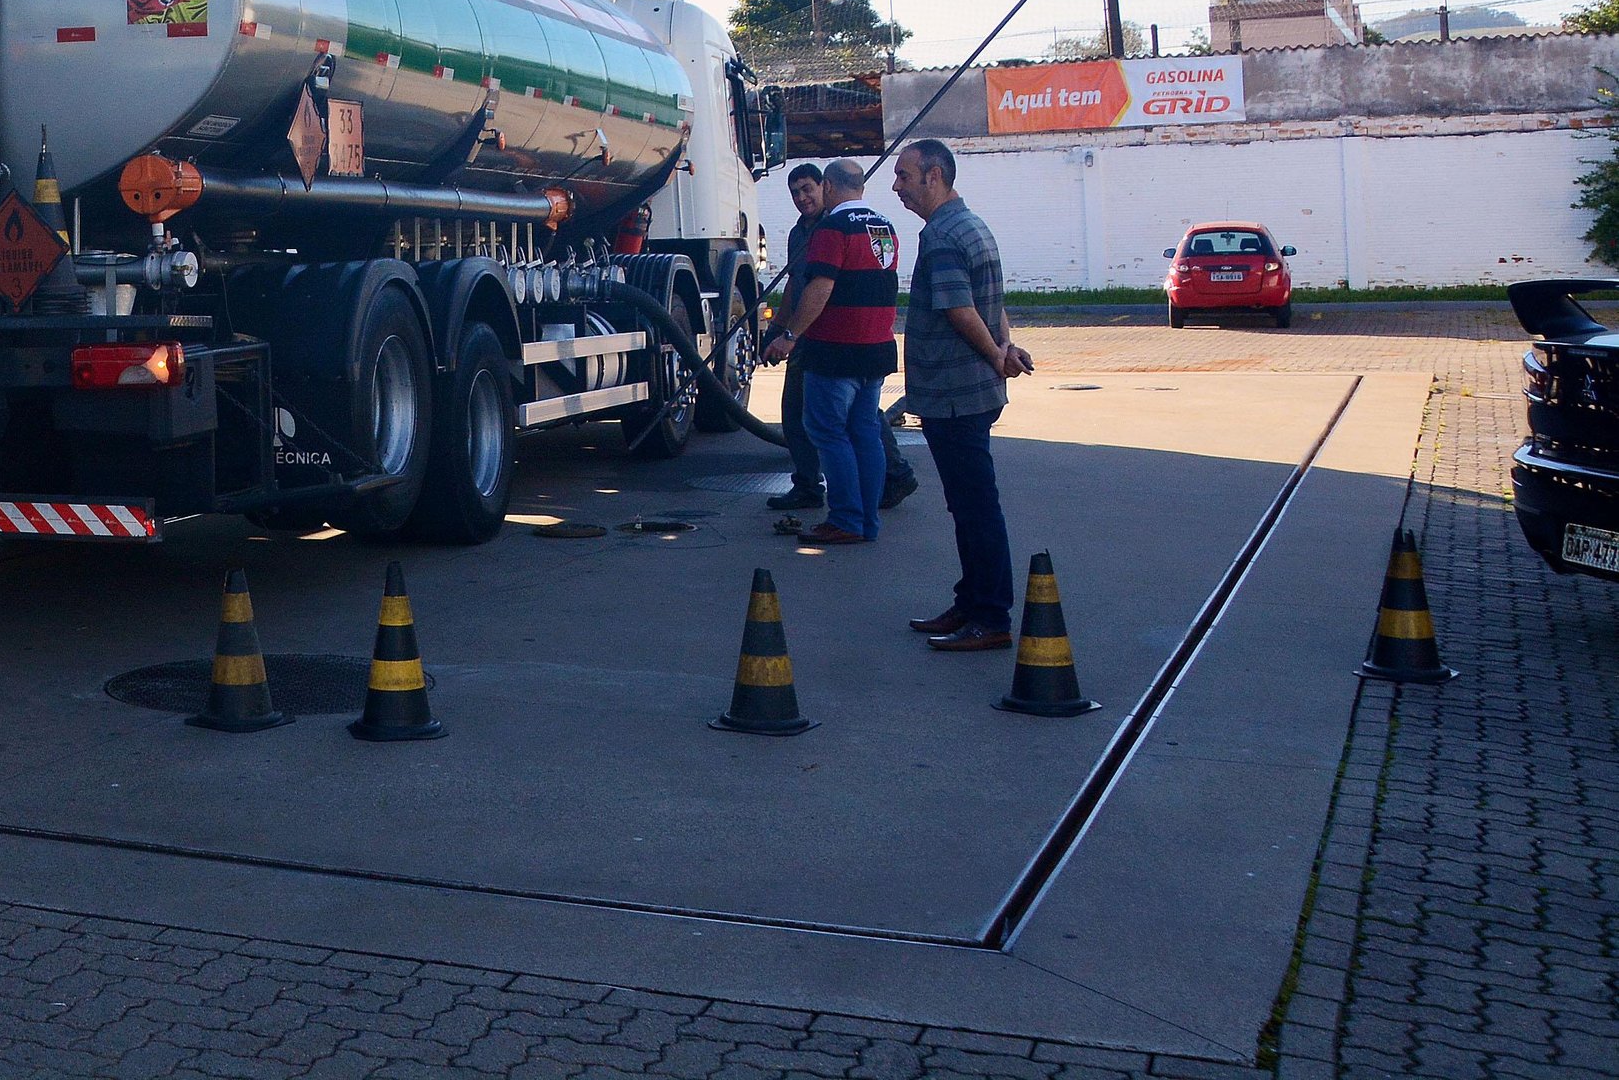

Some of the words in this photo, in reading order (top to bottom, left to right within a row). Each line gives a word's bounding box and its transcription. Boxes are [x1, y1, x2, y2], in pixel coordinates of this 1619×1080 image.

[1146, 68, 1225, 84] GASOLINA
[998, 87, 1052, 115] Aqui
[1057, 88, 1102, 107] tem
[1142, 90, 1231, 115] GRID
[339, 109, 353, 135] 33
